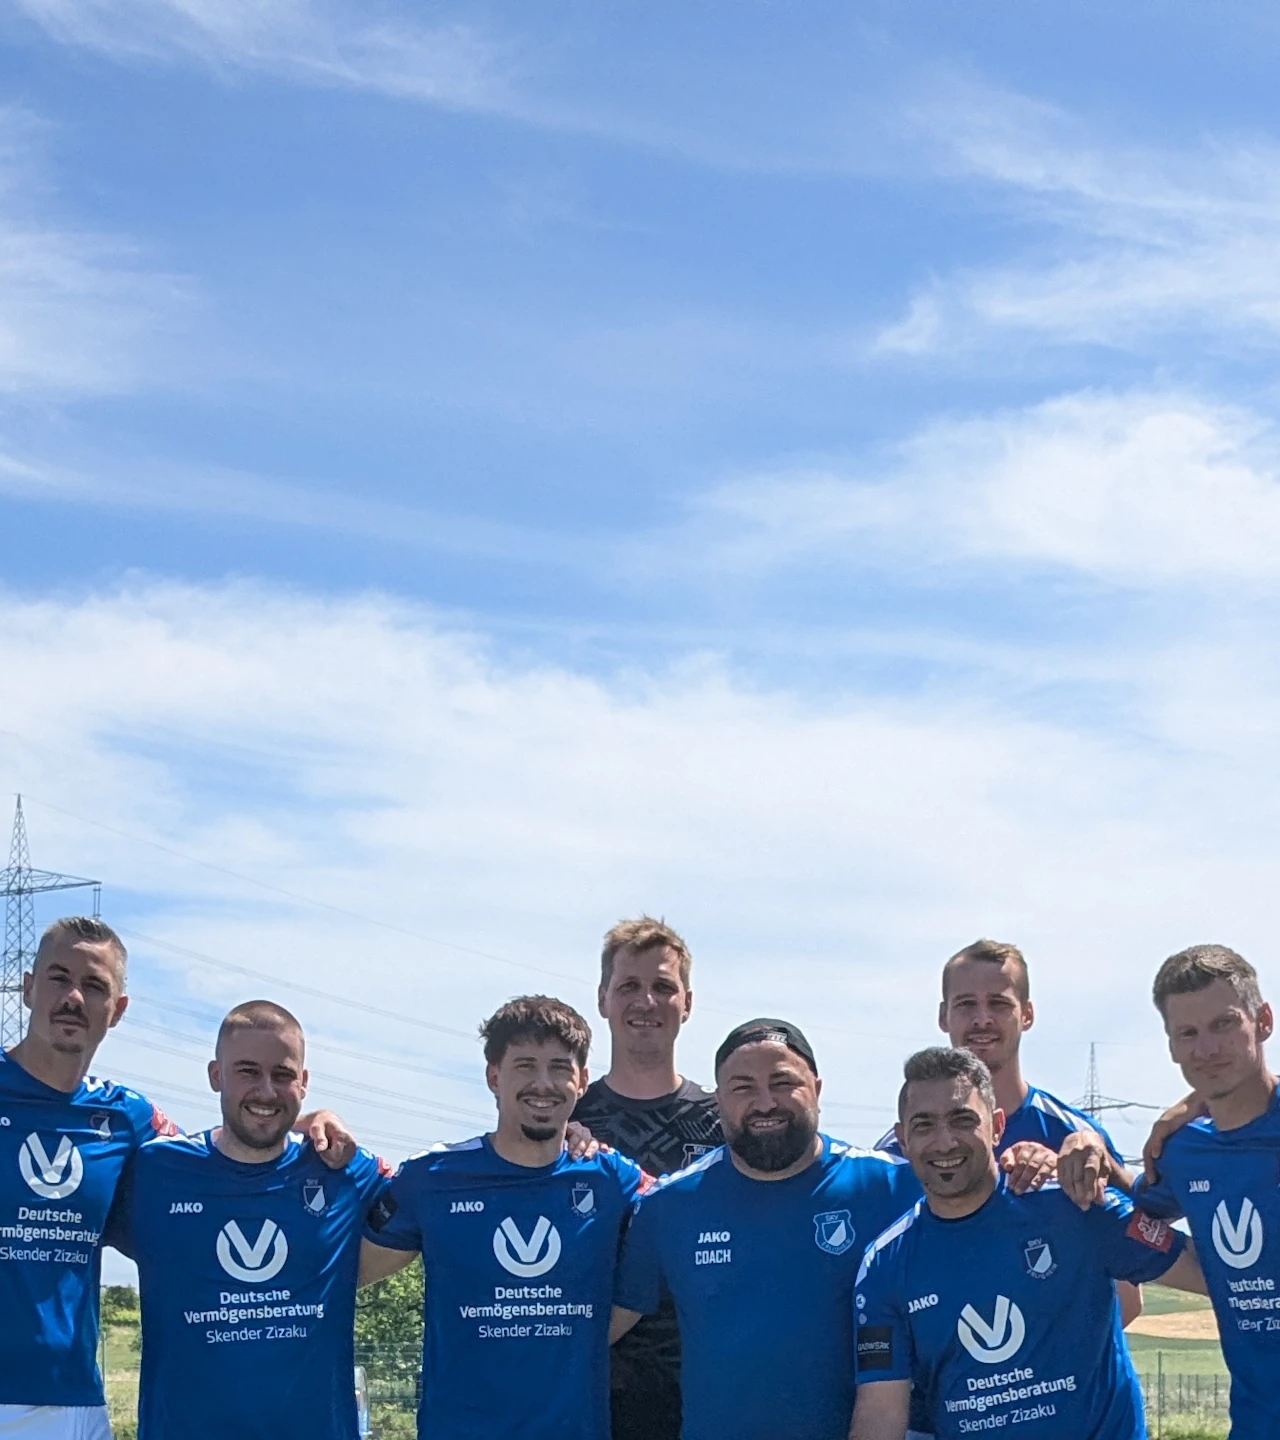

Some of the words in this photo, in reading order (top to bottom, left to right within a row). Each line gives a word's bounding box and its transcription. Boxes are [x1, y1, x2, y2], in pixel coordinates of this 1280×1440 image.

[18, 1206, 83, 1224] Deutsche
[169, 1201, 204, 1214] JAKO
[450, 1200, 484, 1213] JAKO
[698, 1231, 731, 1244] JAKO
[0, 1246, 52, 1262] Skender
[54, 1247, 89, 1265] Zizaku
[695, 1249, 731, 1265] COACH
[220, 1289, 291, 1305] Deutsche
[495, 1284, 563, 1300] Deutsche
[460, 1302, 593, 1320] Vermögensberatung
[908, 1293, 939, 1313] JAKO
[184, 1303, 324, 1323] Vermögensberatung
[206, 1328, 263, 1344] Skender
[266, 1324, 307, 1340] Zizaku
[478, 1324, 531, 1338] Skender
[534, 1324, 572, 1337] Zizaku
[967, 1366, 1034, 1391] Deutsche
[945, 1375, 1077, 1413] Vermögensberatung
[958, 1412, 1008, 1434] Skender
[1011, 1403, 1057, 1424] Zizaku
